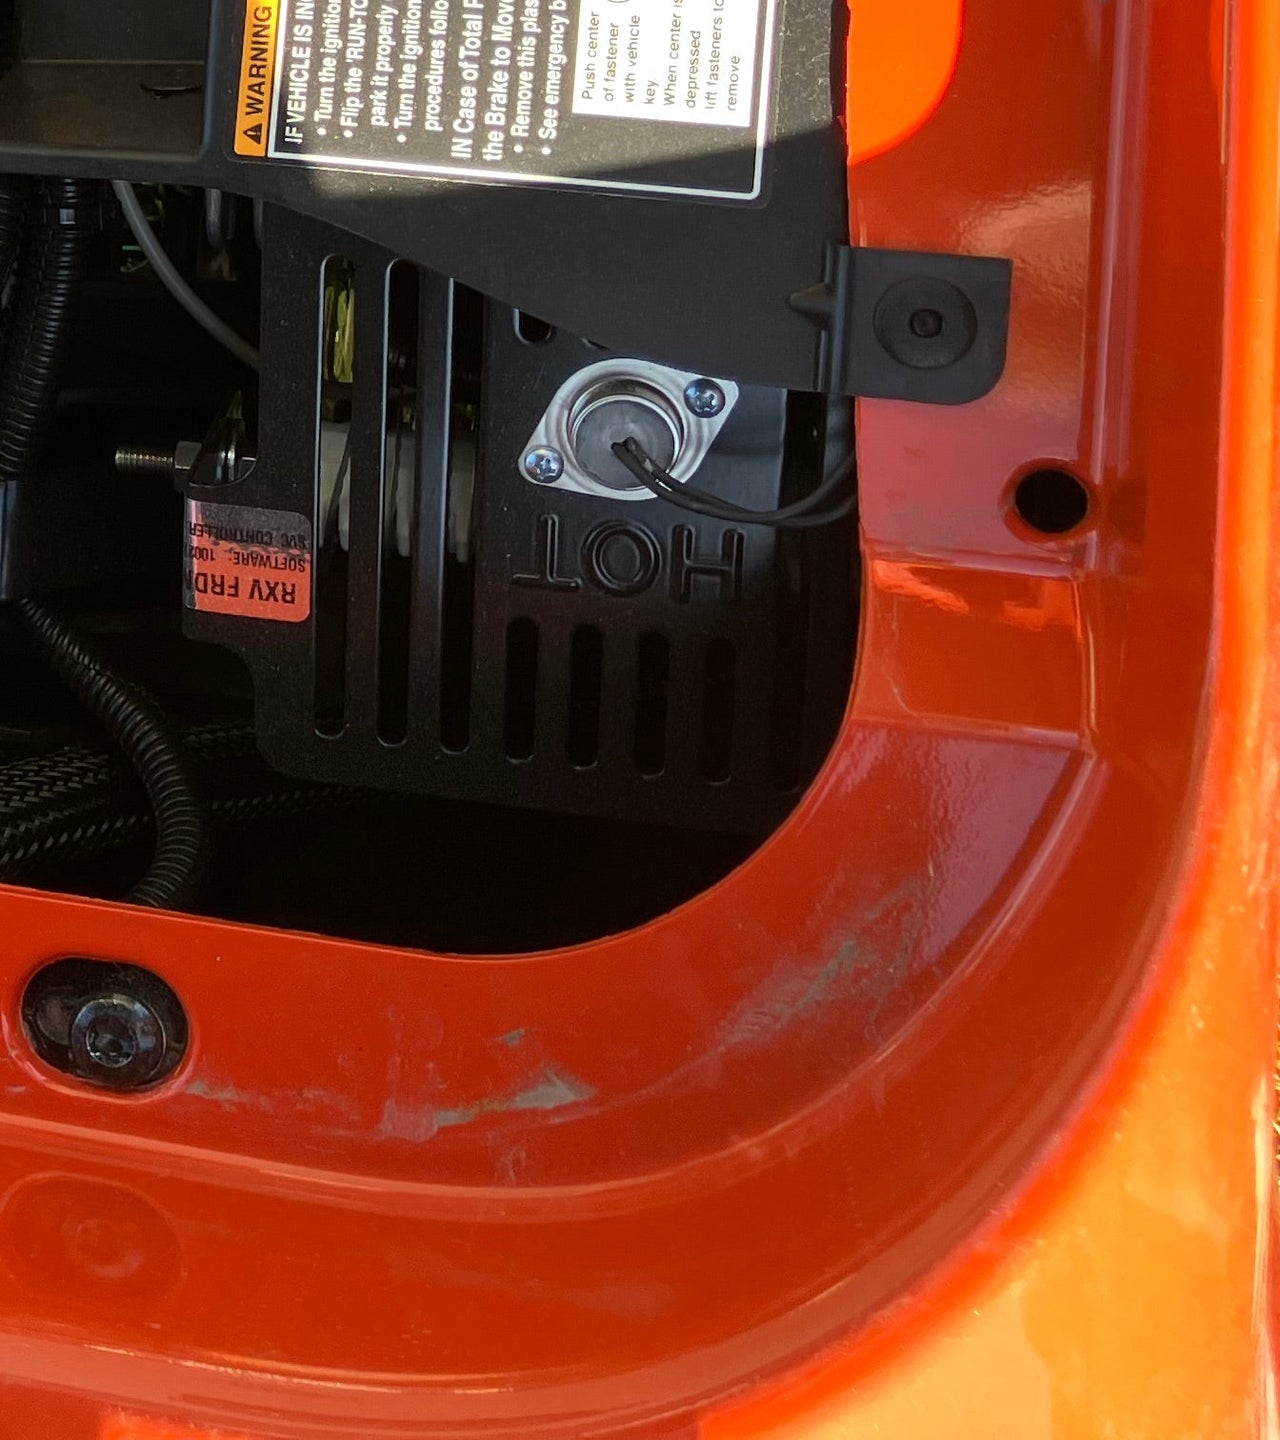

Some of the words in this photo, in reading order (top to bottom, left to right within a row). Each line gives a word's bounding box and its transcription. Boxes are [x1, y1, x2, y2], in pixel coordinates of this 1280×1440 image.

[293, 24, 313, 42] IS
[458, 13, 483, 59] Total
[586, 10, 600, 58] center
[245, 6, 271, 115] WARNING
[490, 46, 511, 66] to
[544, 14, 570, 105] emergency
[602, 21, 620, 83] fastener
[286, 45, 311, 122] VEHICLE
[317, 56, 337, 83] the
[458, 61, 479, 81] of
[580, 62, 596, 100] Push
[313, 86, 334, 119] Turn
[452, 85, 477, 133] Case
[484, 70, 509, 125] Brake
[601, 86, 615, 102] of
[284, 126, 303, 144] IF
[537, 107, 558, 139] See
[450, 137, 473, 158] IN
[481, 130, 504, 161] the
[509, 513, 746, 606] HOT
[247, 578, 296, 604] RXV
